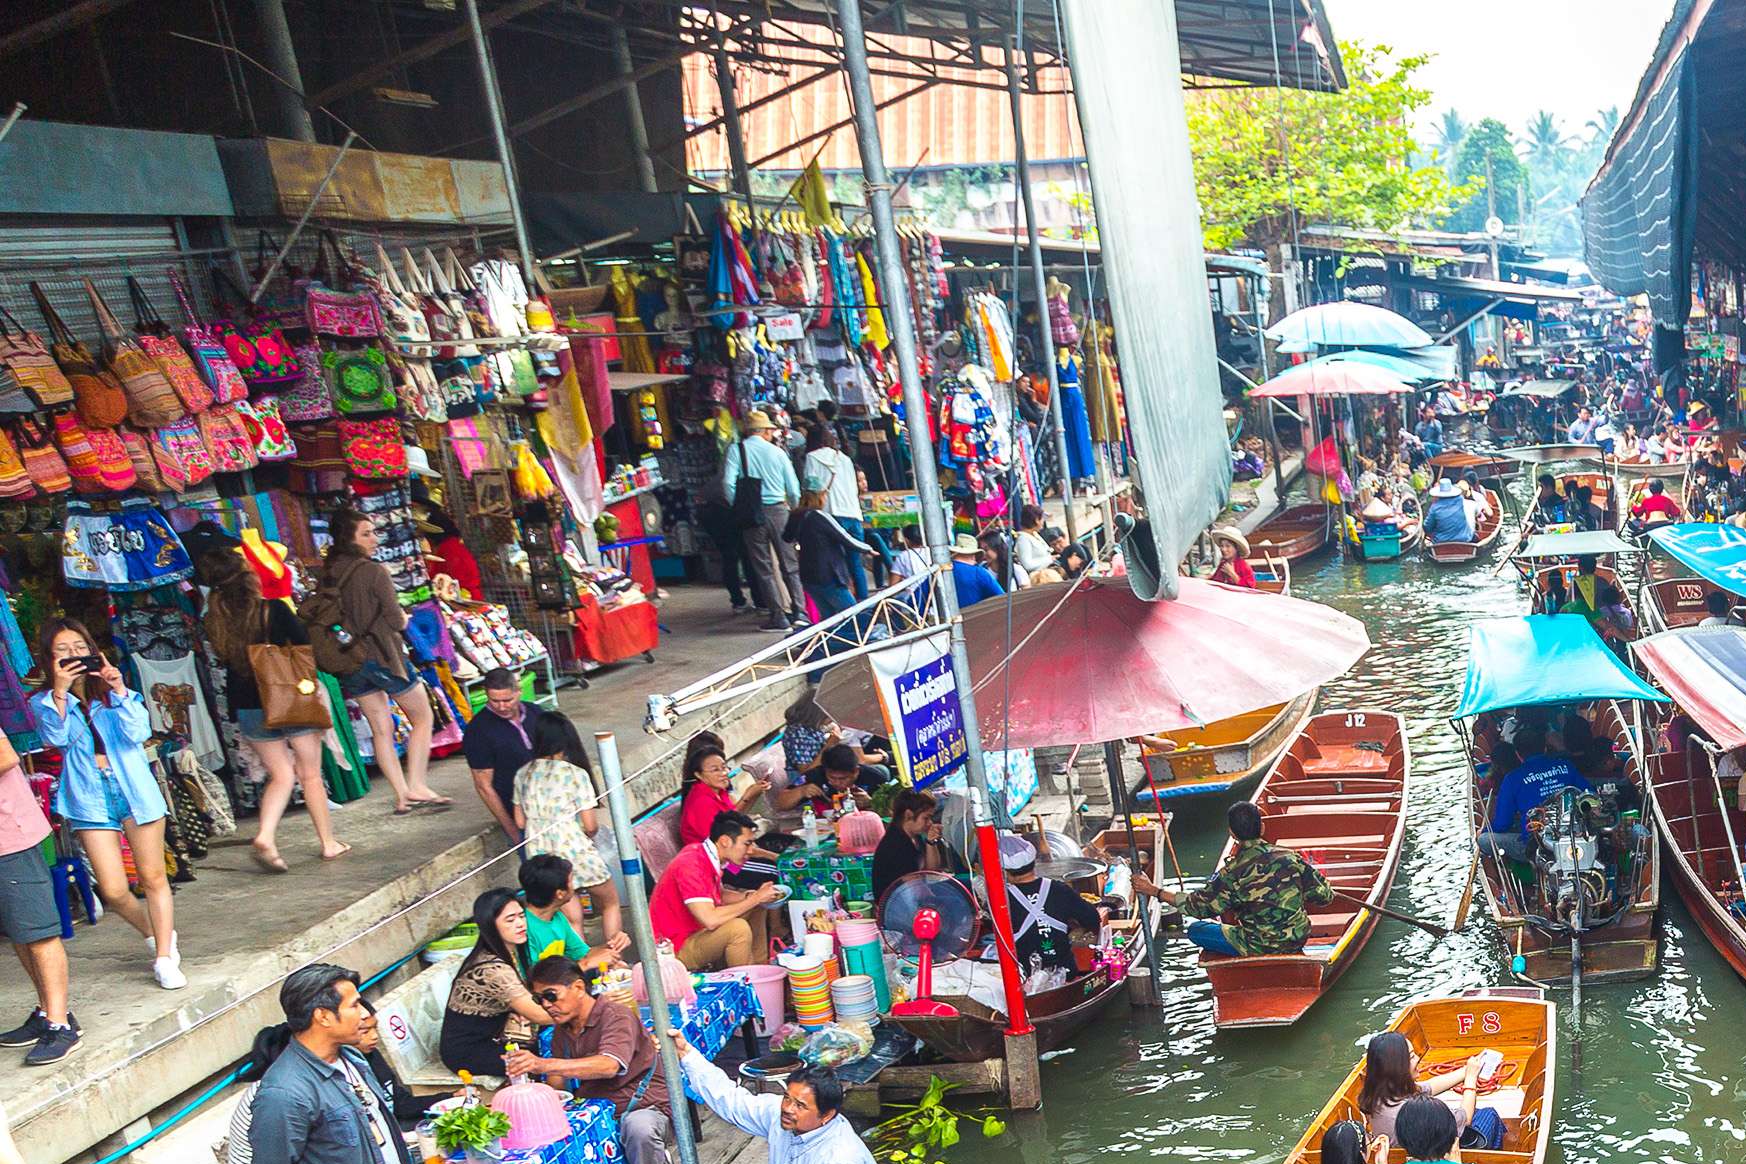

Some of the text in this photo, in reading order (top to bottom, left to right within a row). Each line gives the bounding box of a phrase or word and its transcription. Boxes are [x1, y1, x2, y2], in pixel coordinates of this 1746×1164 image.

[1677, 585, 1703, 599] WS
[1354, 714, 1366, 727] 12
[1457, 1012, 1501, 1034] F 8
